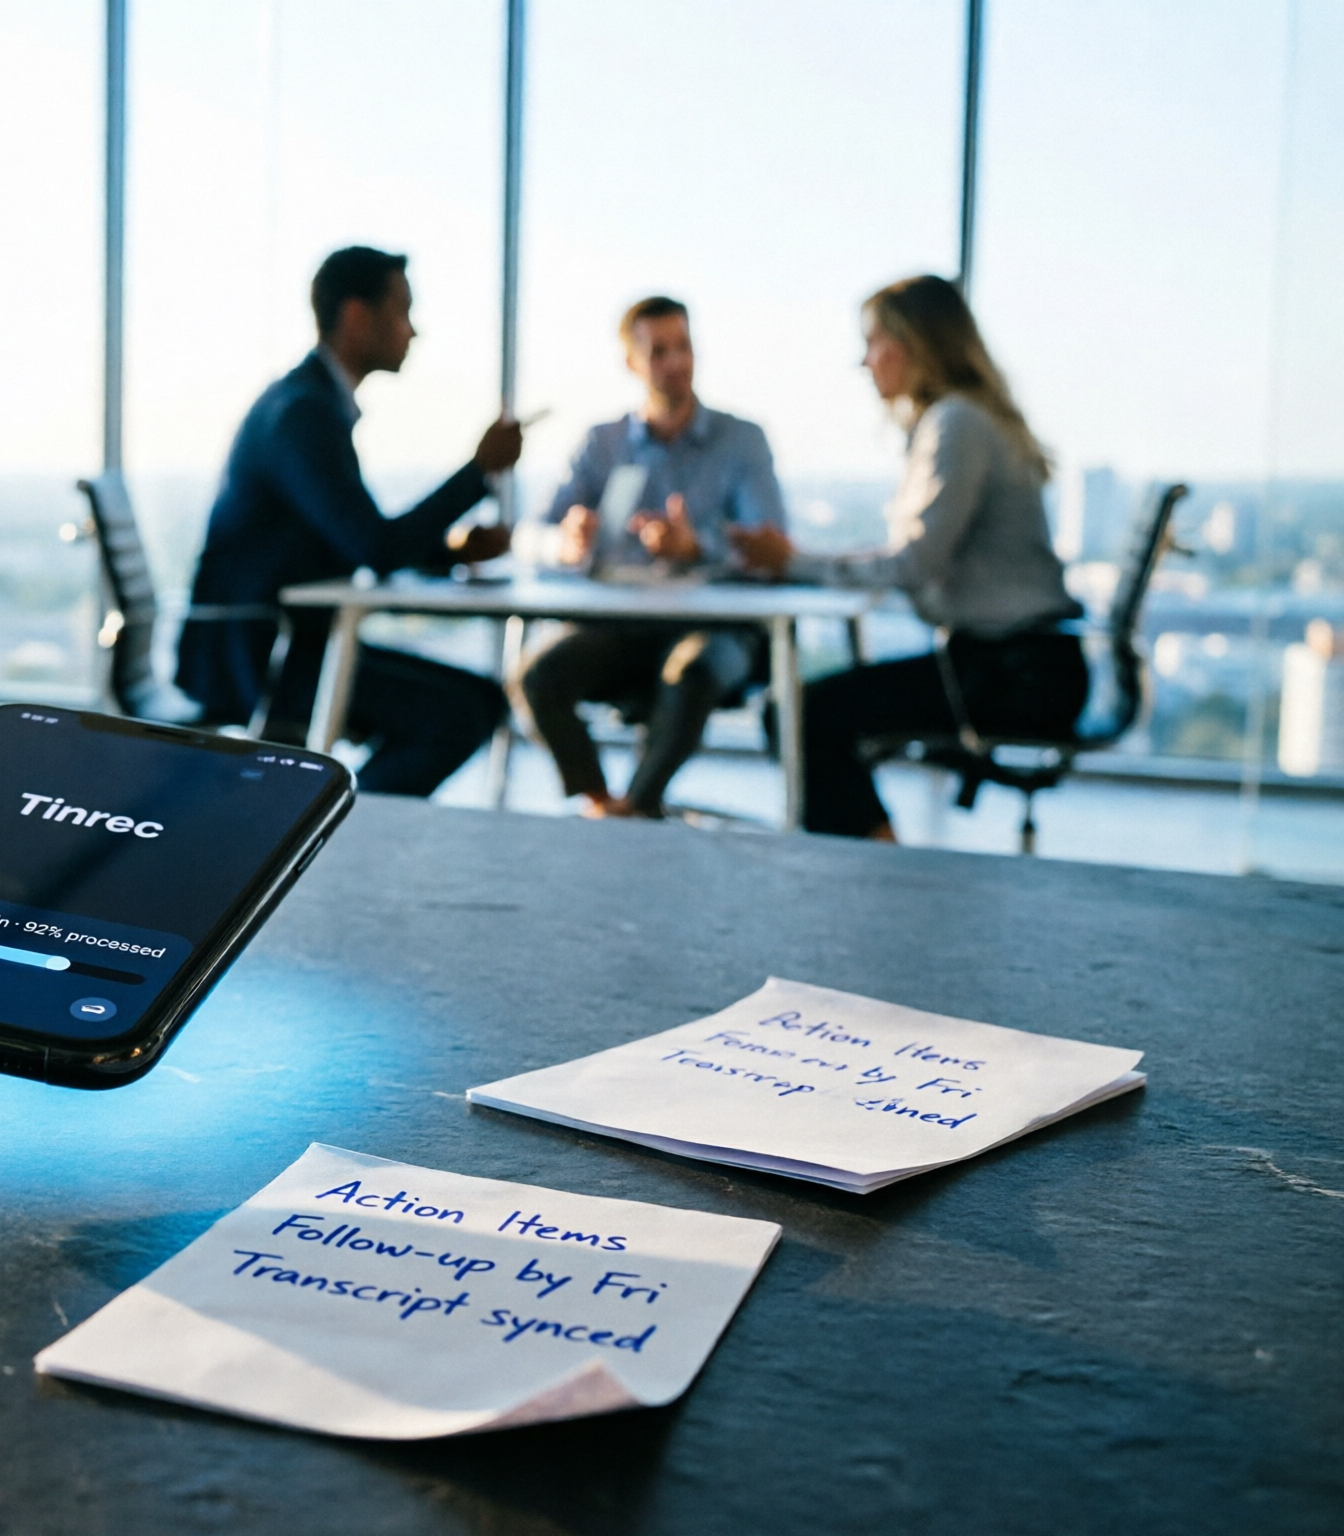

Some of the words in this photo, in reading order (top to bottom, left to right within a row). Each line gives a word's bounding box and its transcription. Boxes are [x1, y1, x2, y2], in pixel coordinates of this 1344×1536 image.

[20, 792, 164, 838] Tinrec
[23, 921, 63, 939] 92%
[64, 932, 167, 959] processed
[915, 1078, 983, 1098] Fri
[314, 1181, 465, 1224] Action
[497, 1210, 627, 1252] Items
[271, 1213, 496, 1281] Follow-up
[515, 1258, 572, 1299] by
[592, 1272, 668, 1304] Fri
[233, 1249, 471, 1320] Transcript
[479, 1309, 658, 1354] synced
